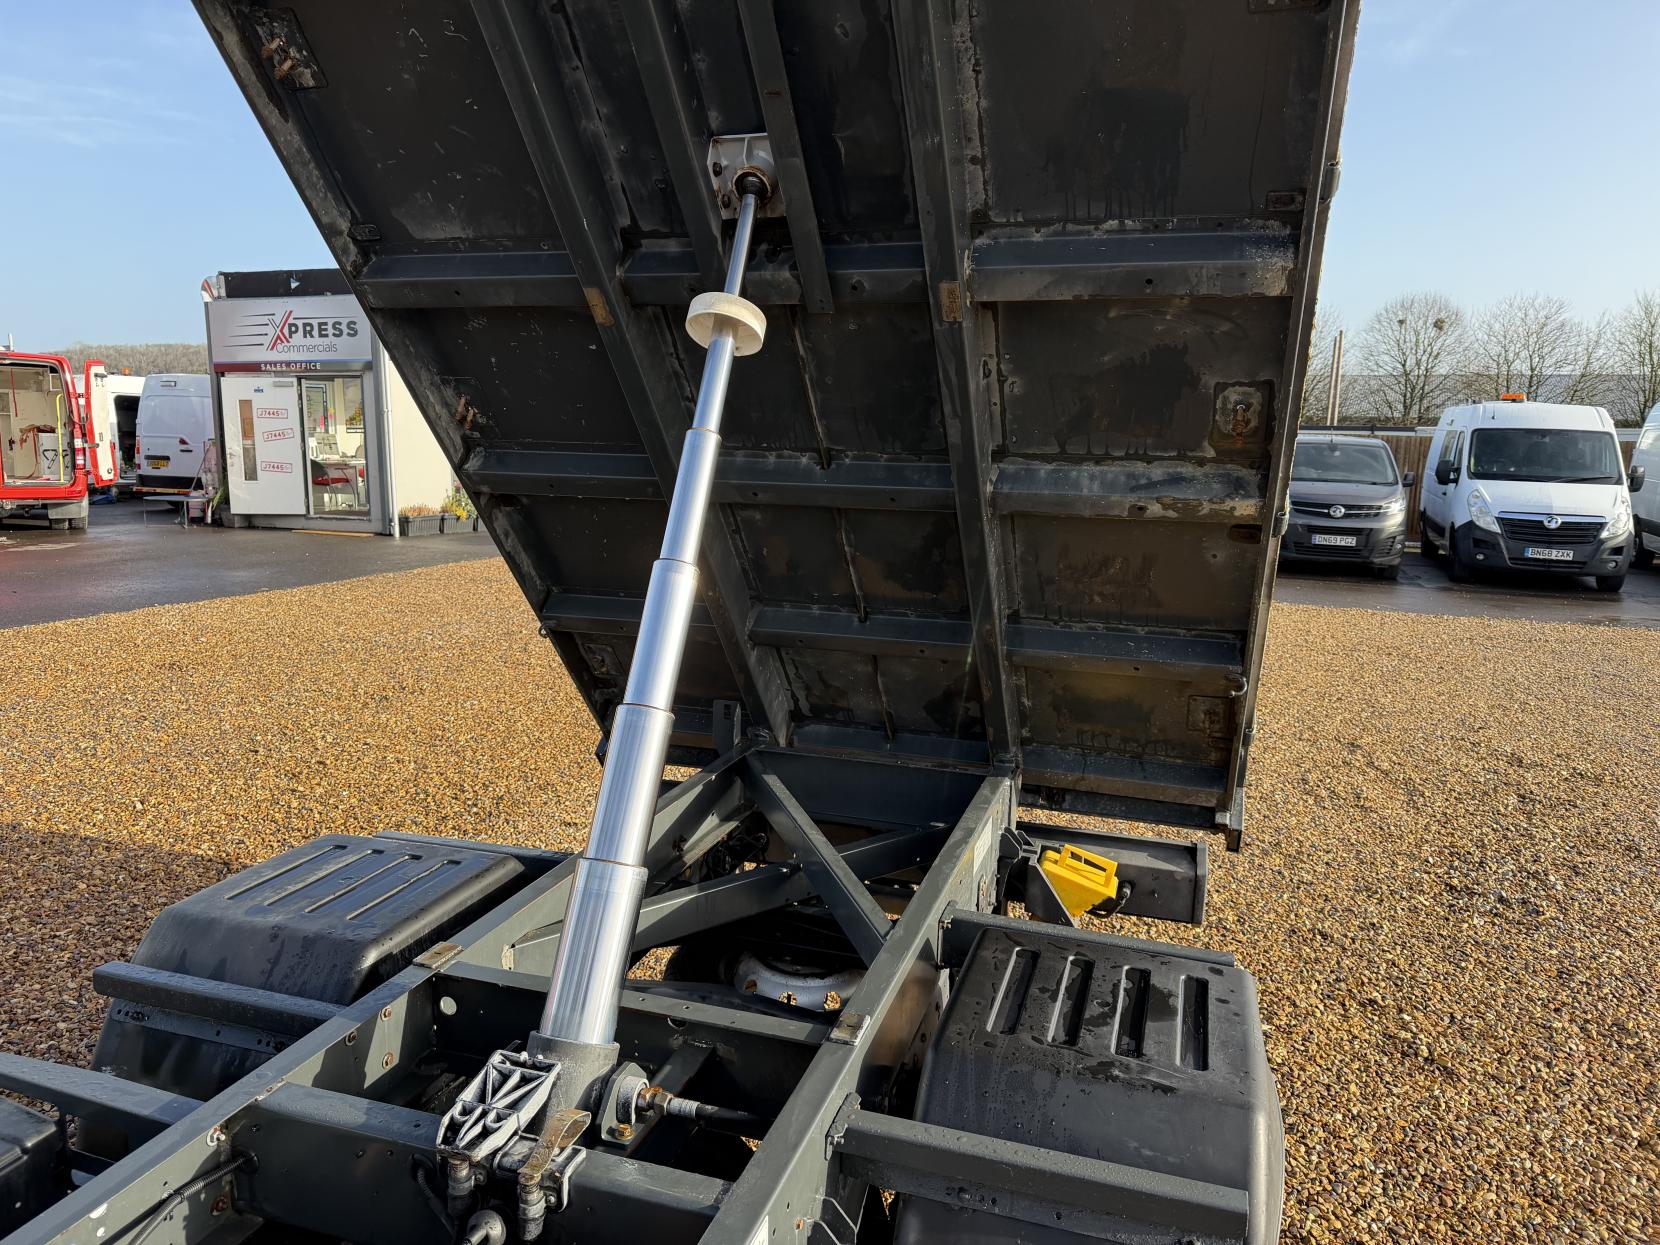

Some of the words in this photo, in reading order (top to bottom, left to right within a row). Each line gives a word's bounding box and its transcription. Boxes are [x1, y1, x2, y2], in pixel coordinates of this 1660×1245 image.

[266, 310, 359, 351] XPRESS
[276, 341, 338, 354] Commercials
[260, 363, 287, 371] SALES
[290, 362, 321, 370] OFFICE
[1318, 536, 1338, 544] DN69
[1340, 537, 1355, 545] PGZ
[1555, 550, 1573, 559] ZXK
